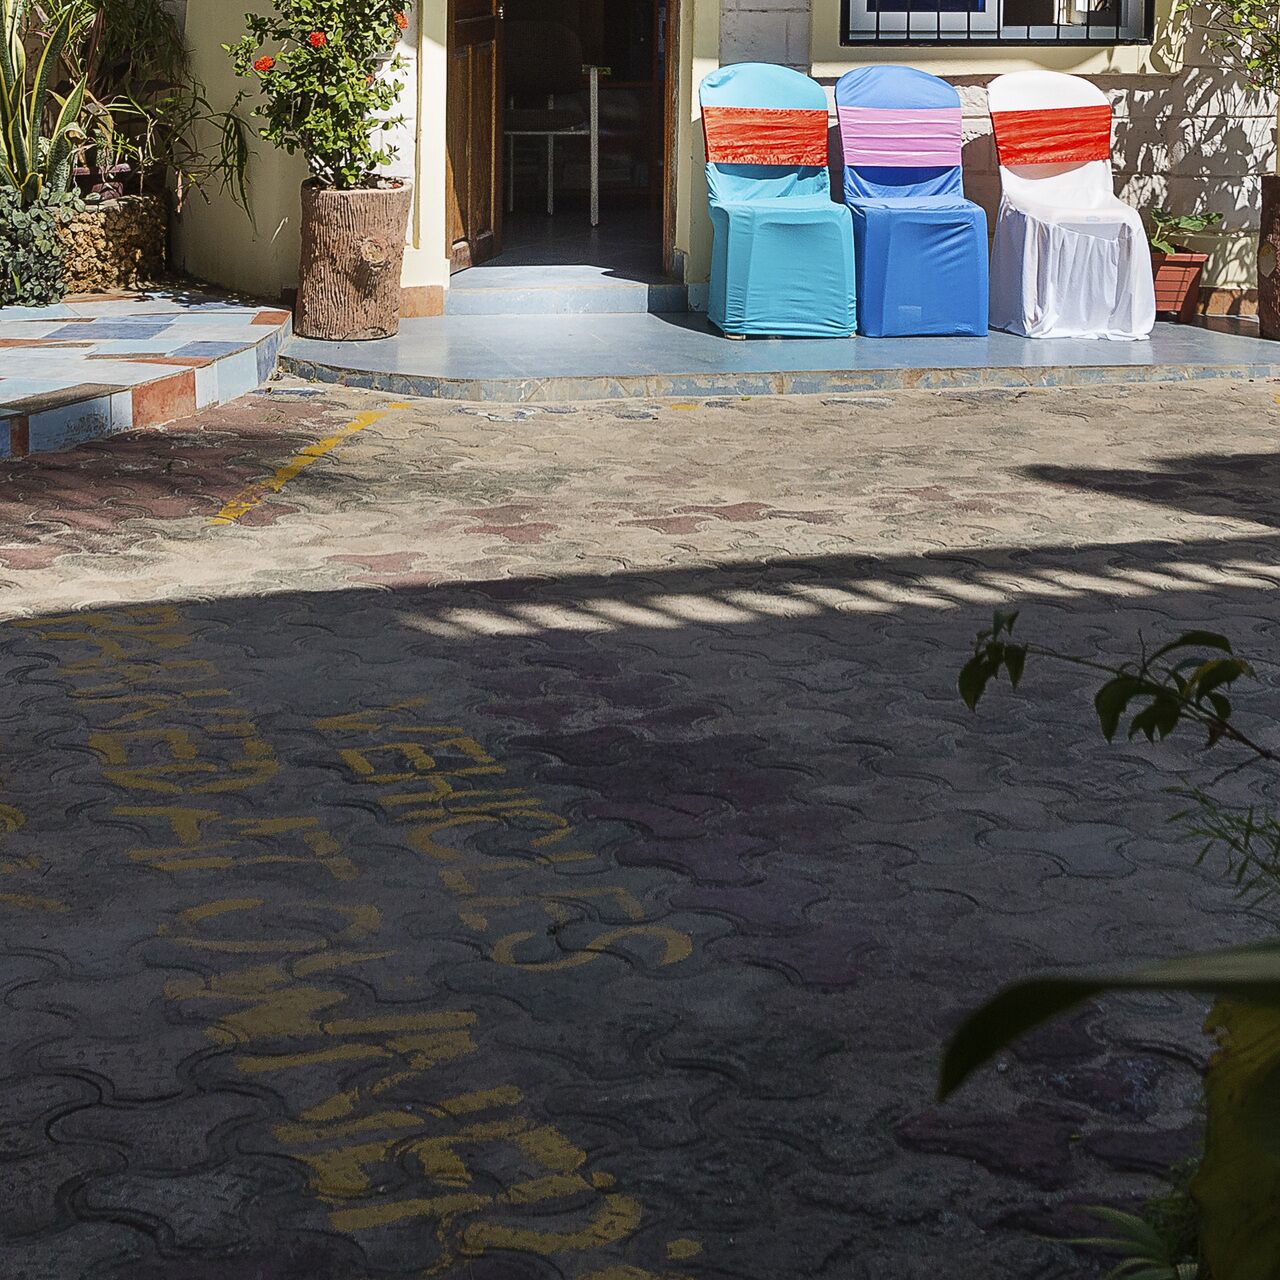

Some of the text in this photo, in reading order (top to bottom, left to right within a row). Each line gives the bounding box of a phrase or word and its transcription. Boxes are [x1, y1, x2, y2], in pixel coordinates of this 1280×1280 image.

[11, 606, 704, 1280] PARKED AT OWNER'
[312, 696, 693, 973] VEHICLES
